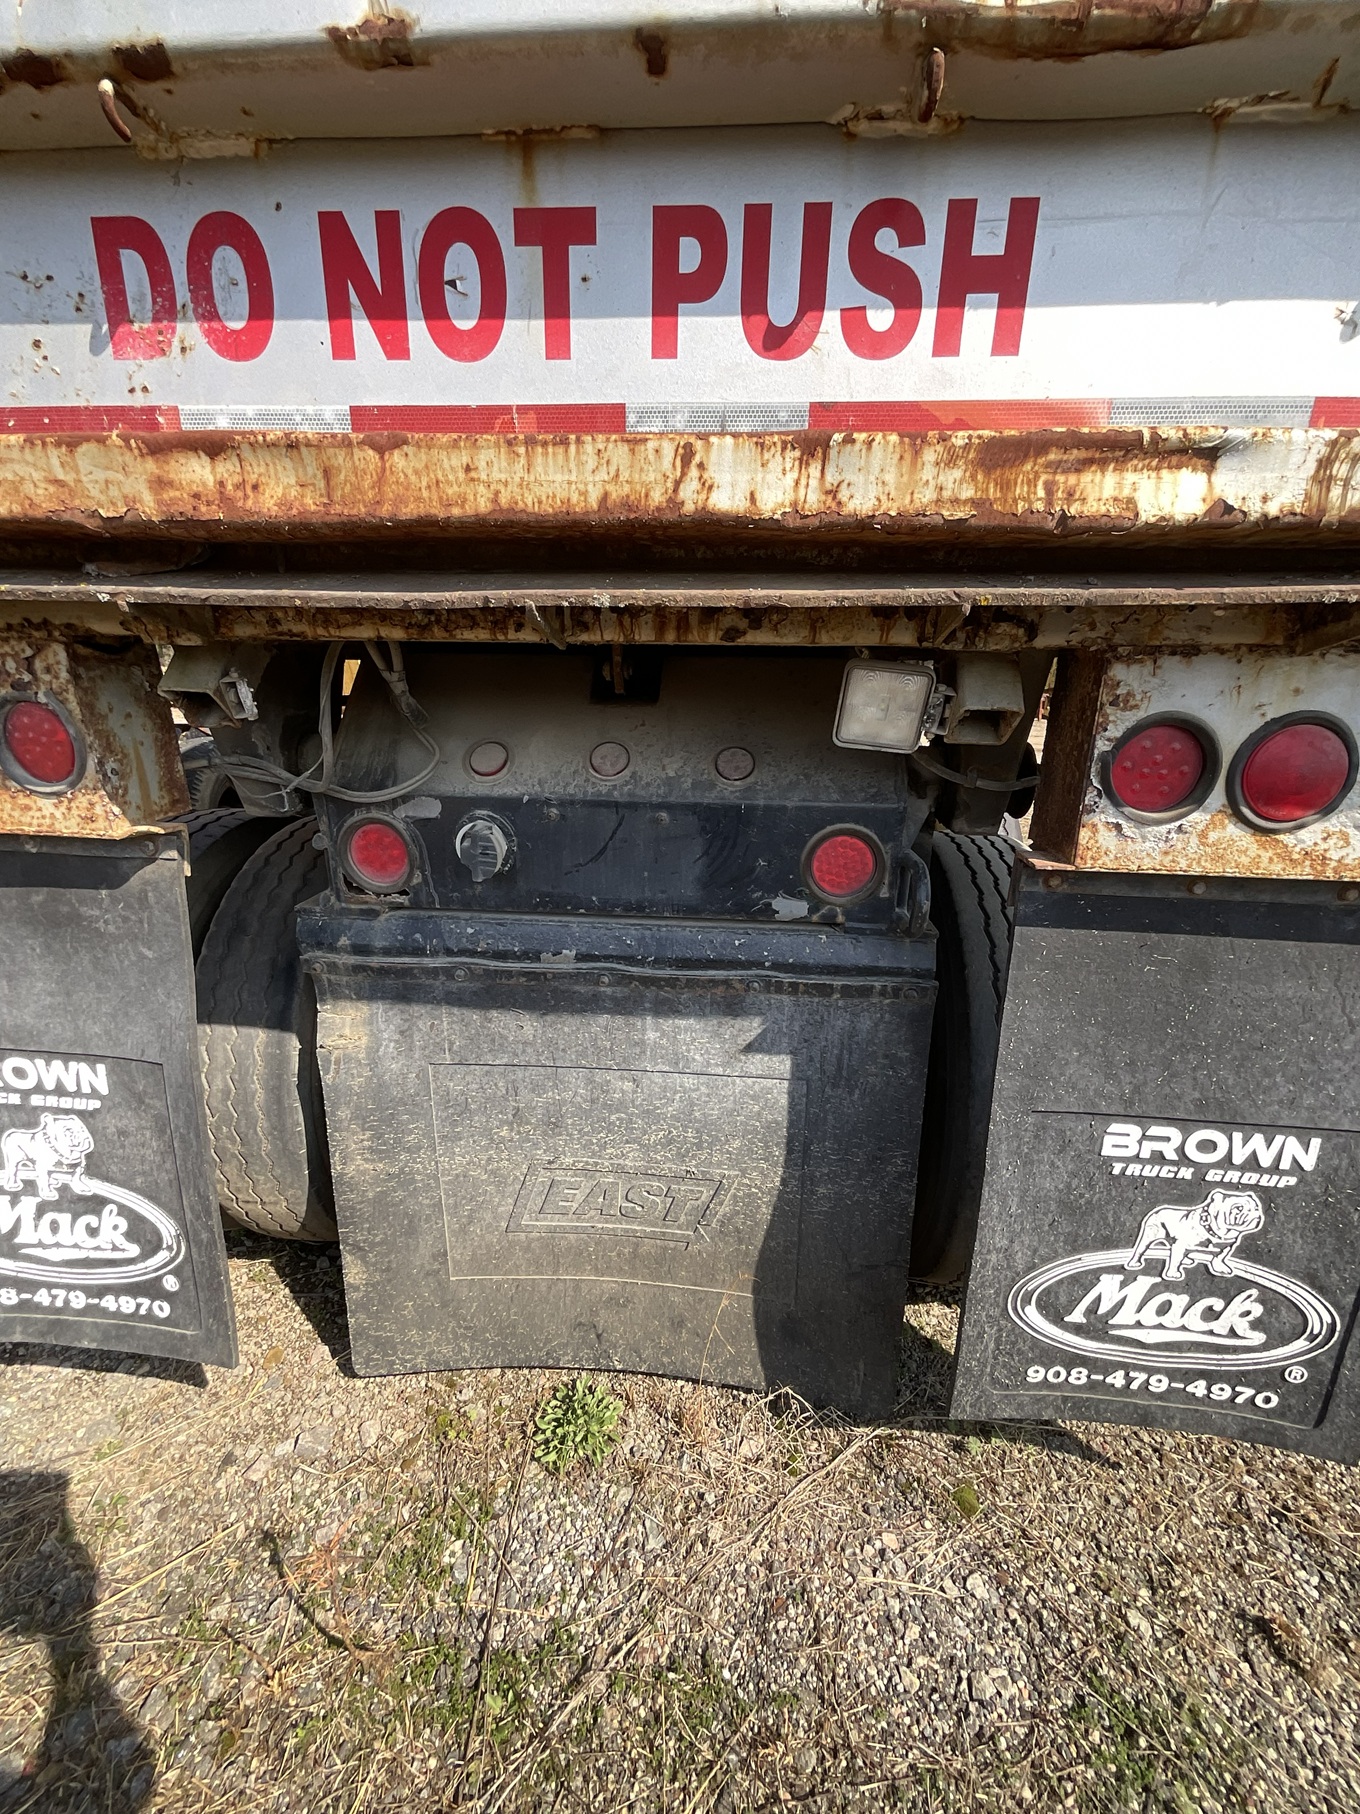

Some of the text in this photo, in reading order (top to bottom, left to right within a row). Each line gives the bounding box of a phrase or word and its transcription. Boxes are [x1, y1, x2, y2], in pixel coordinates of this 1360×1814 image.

[90, 196, 1041, 362] DO NOT PUSH
[0, 1056, 110, 1096] OWN
[30, 1094, 102, 1111] GROUP
[1100, 1122, 1323, 1173] BROWN
[1111, 1162, 1298, 1189] TRUCK GROUP
[538, 1177, 706, 1223] EAST
[1062, 1273, 1267, 1346] Mack
[1025, 1364, 1280, 1410] 908-479-4970
